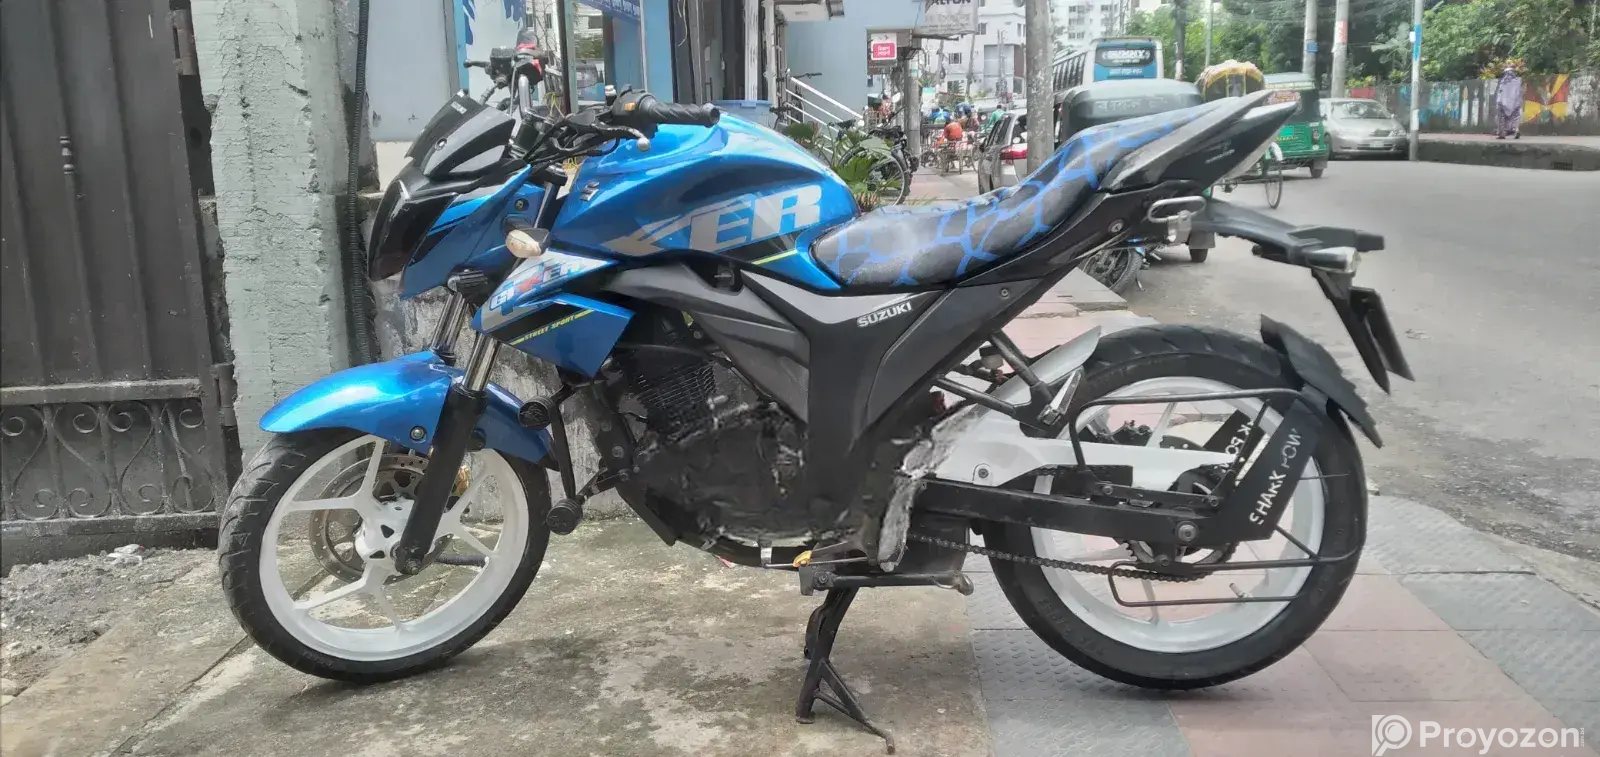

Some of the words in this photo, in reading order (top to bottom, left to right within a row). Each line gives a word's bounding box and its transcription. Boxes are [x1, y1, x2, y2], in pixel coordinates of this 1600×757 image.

[857, 301, 912, 328] SUZUKI
[524, 326, 550, 340] STREET
[551, 317, 575, 329] SPORT
[1249, 470, 1287, 525] SHARK
